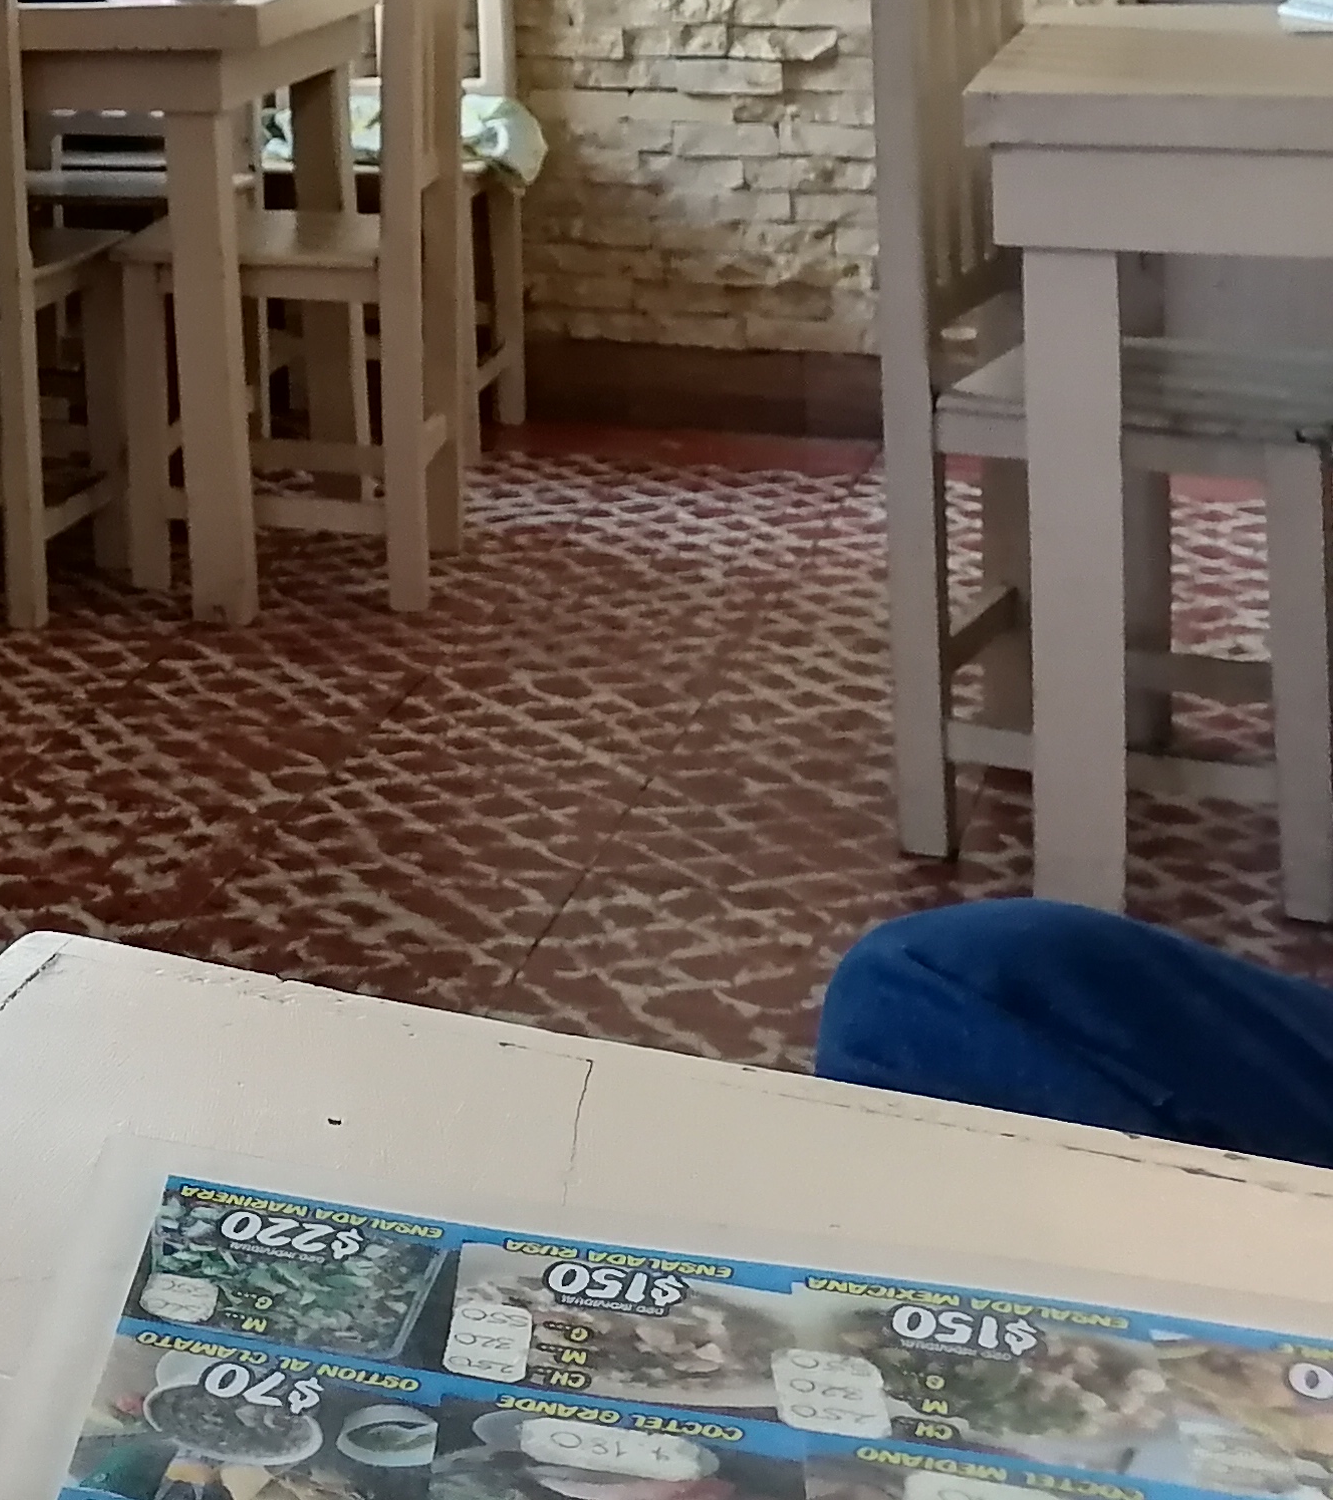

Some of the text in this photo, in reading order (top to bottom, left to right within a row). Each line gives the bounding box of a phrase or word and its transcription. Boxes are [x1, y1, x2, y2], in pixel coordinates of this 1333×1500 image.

[180, 1184, 443, 1239] ENSALADA MARINERA
[221, 1210, 364, 1260] $220
[503, 1238, 732, 1278] ENSALADA RUSA
[547, 1263, 683, 1306] $150
[805, 1277, 1130, 1329] ENSALADA MEXICANA
[891, 1304, 1037, 1356] $150
[135, 1330, 420, 1392] OSTION AL CLAMATO
[203, 1362, 324, 1414] $70
[495, 1394, 743, 1442] COCTEL GRANDE
[855, 1445, 1144, 1500] COCTEL MEDIANO
